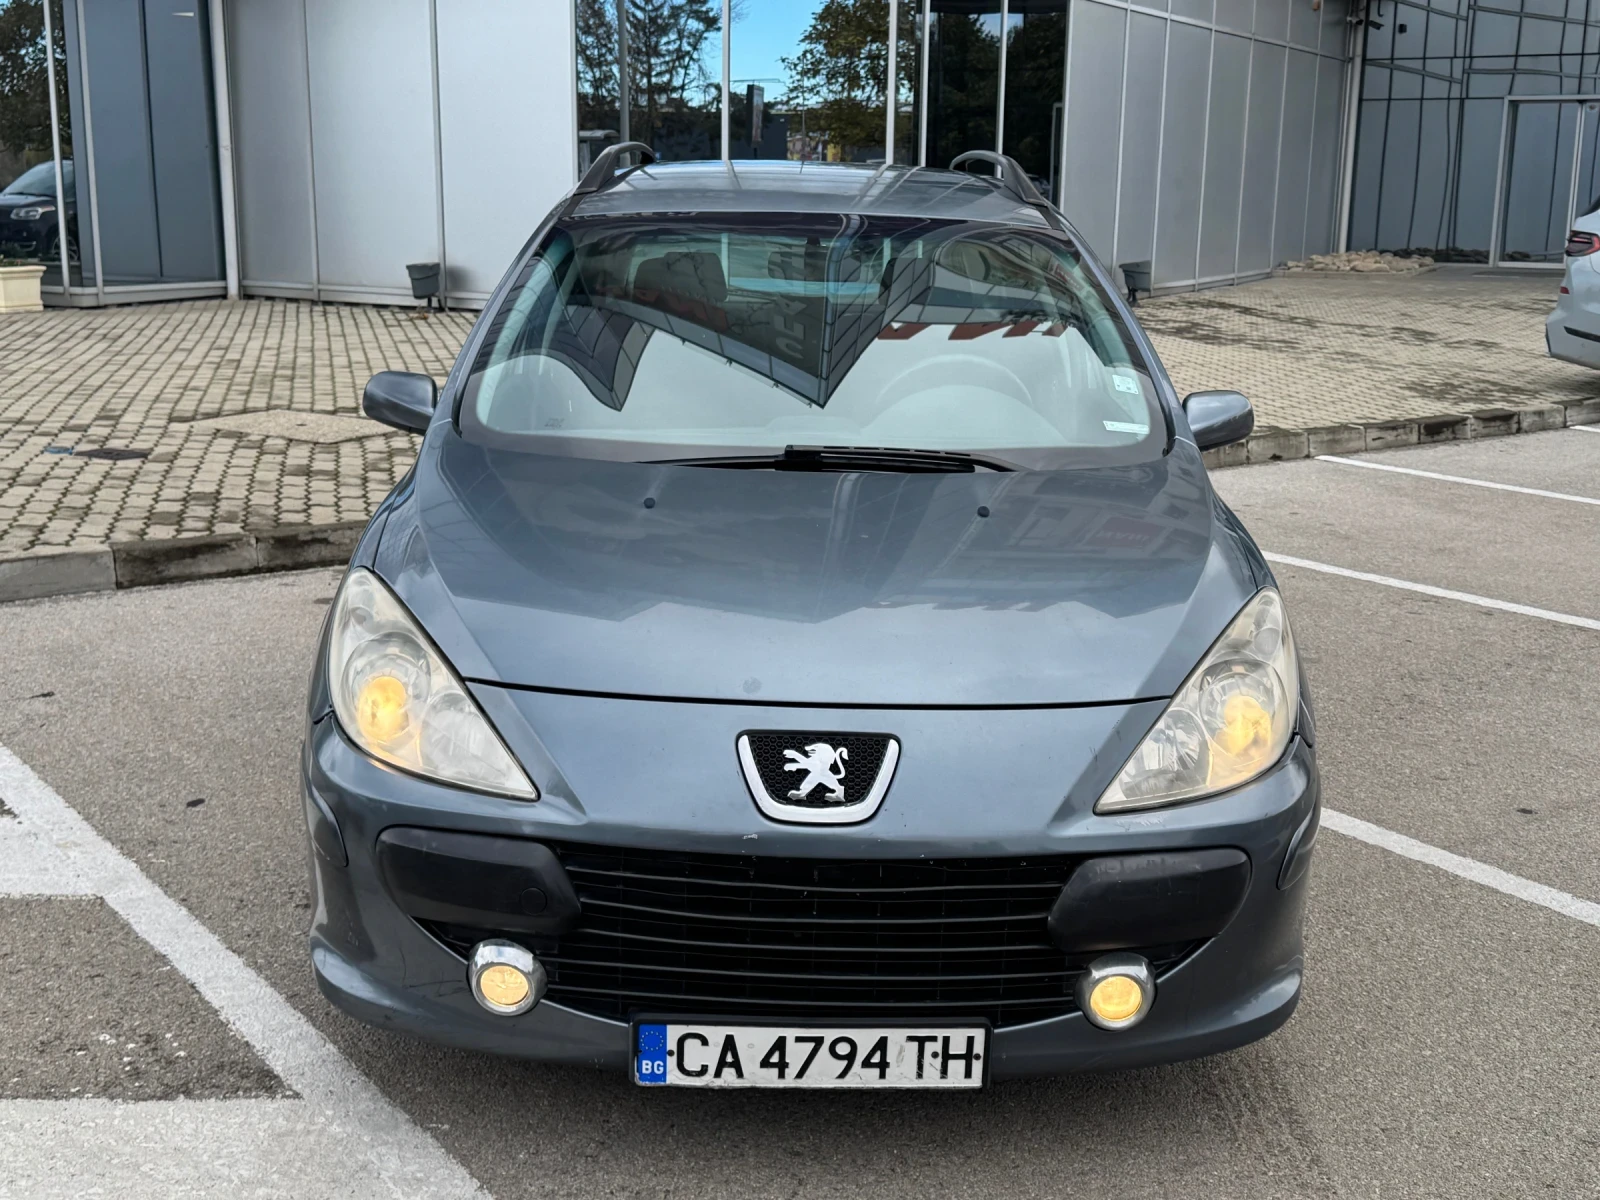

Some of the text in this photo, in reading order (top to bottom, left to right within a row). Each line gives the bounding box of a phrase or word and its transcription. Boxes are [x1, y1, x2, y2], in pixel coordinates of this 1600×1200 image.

[641, 1060, 664, 1074] BG
[676, 1032, 976, 1080] CA 4794 TH
